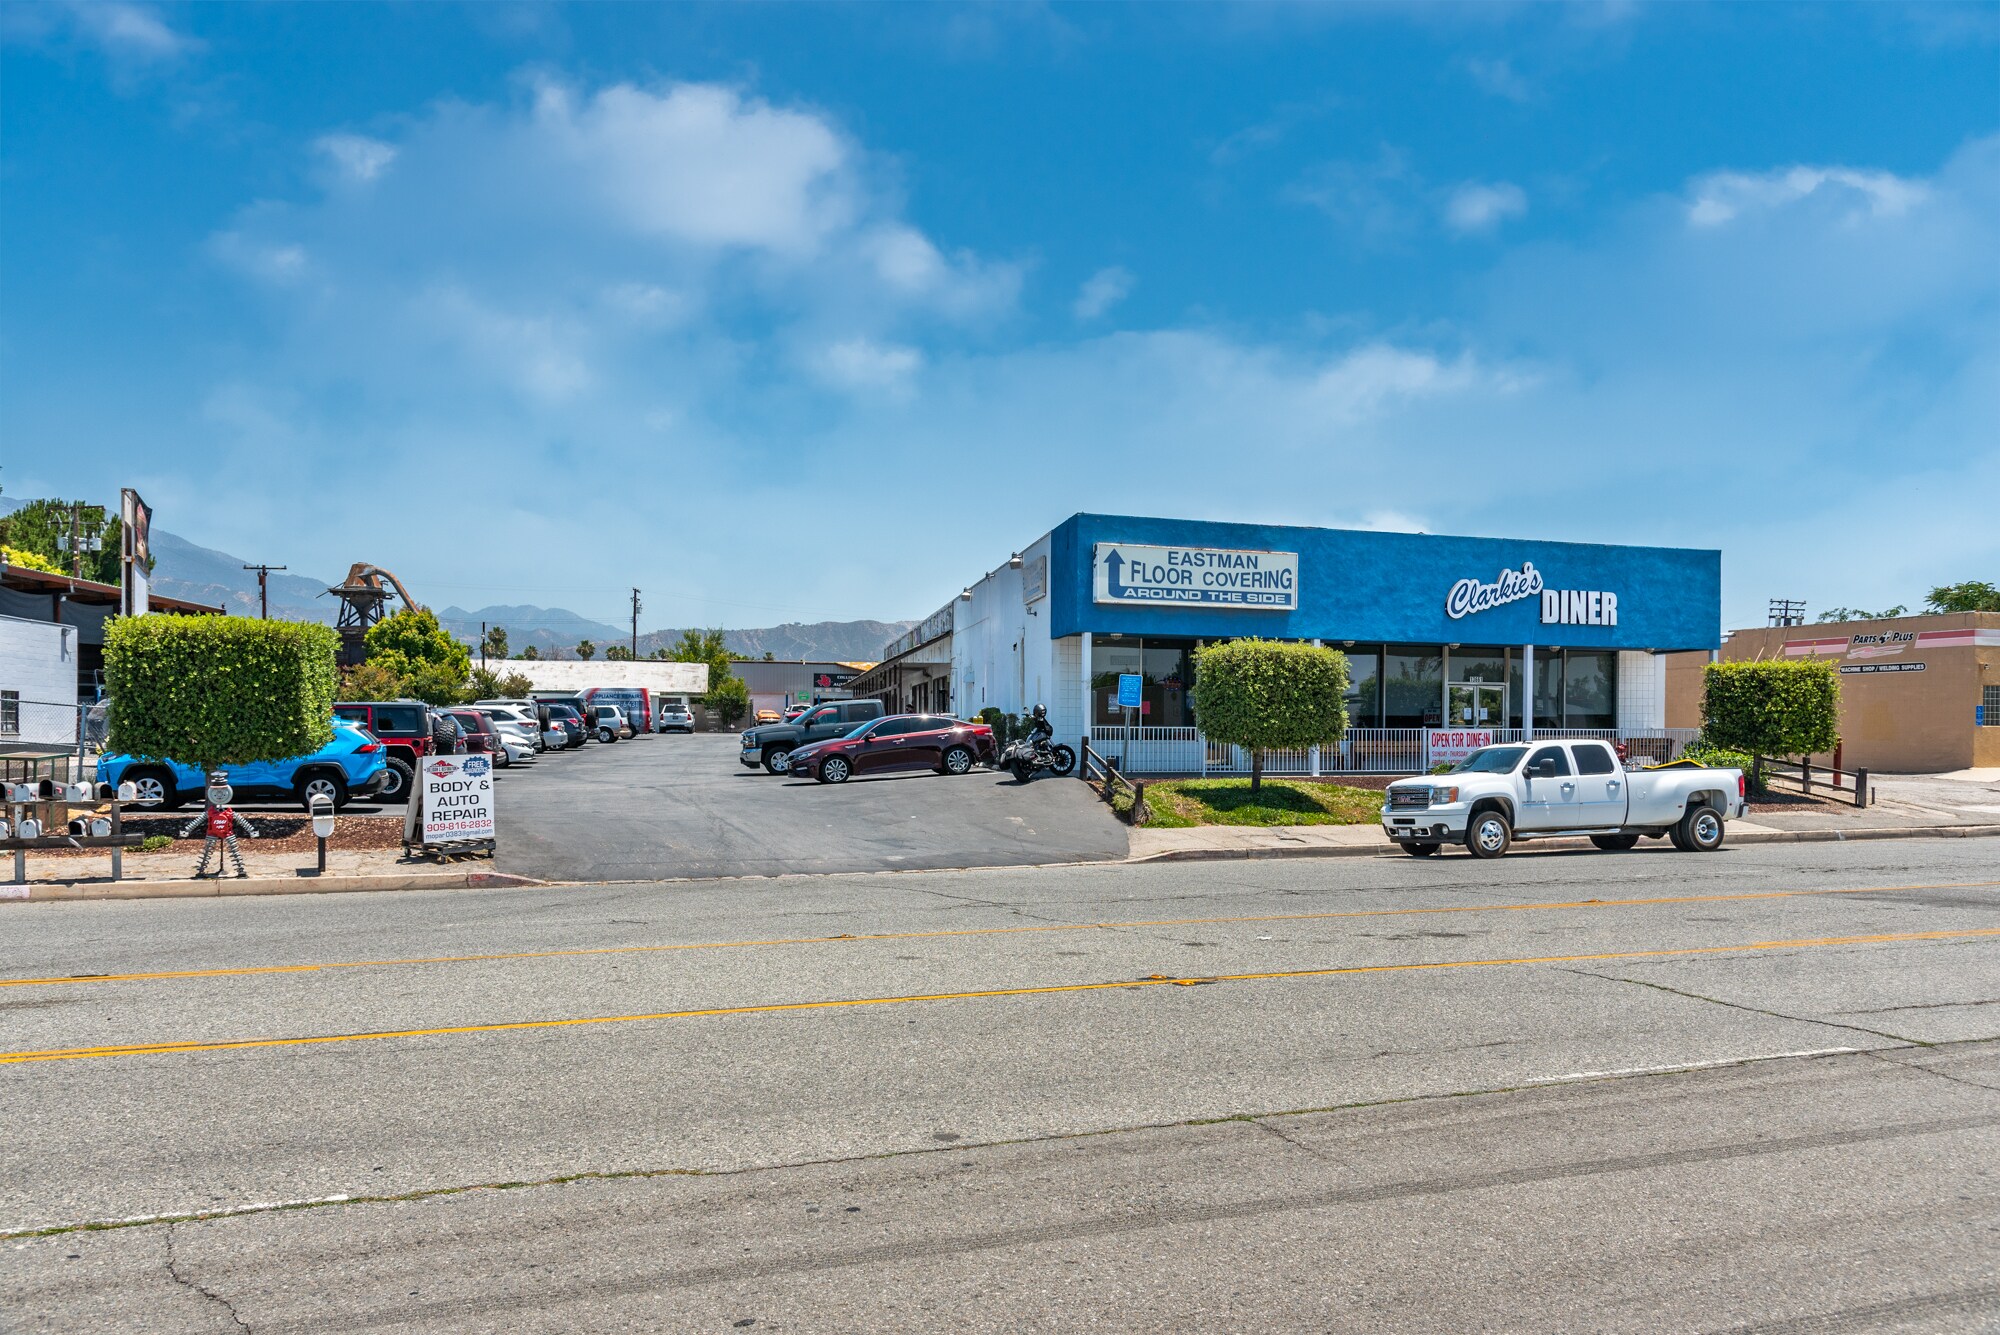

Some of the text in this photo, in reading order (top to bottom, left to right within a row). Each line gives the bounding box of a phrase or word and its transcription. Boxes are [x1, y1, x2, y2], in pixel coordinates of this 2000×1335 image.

[1168, 551, 1258, 570] EASTMAN
[1131, 560, 1293, 590] FLOOR COVERING
[1123, 588, 1286, 604] AROUND THE SIDE
[1447, 563, 1543, 618] Clarkie's
[1541, 589, 1618, 626] DINER
[1852, 632, 1914, 645] PARTS PLUS
[1431, 732, 1491, 748] OPEN FOR DINE-IN
[430, 780, 490, 793] BODY &
[437, 795, 479, 807] AUTO
[432, 808, 487, 821] REPAIR
[426, 820, 492, 832] 909-816-2832
